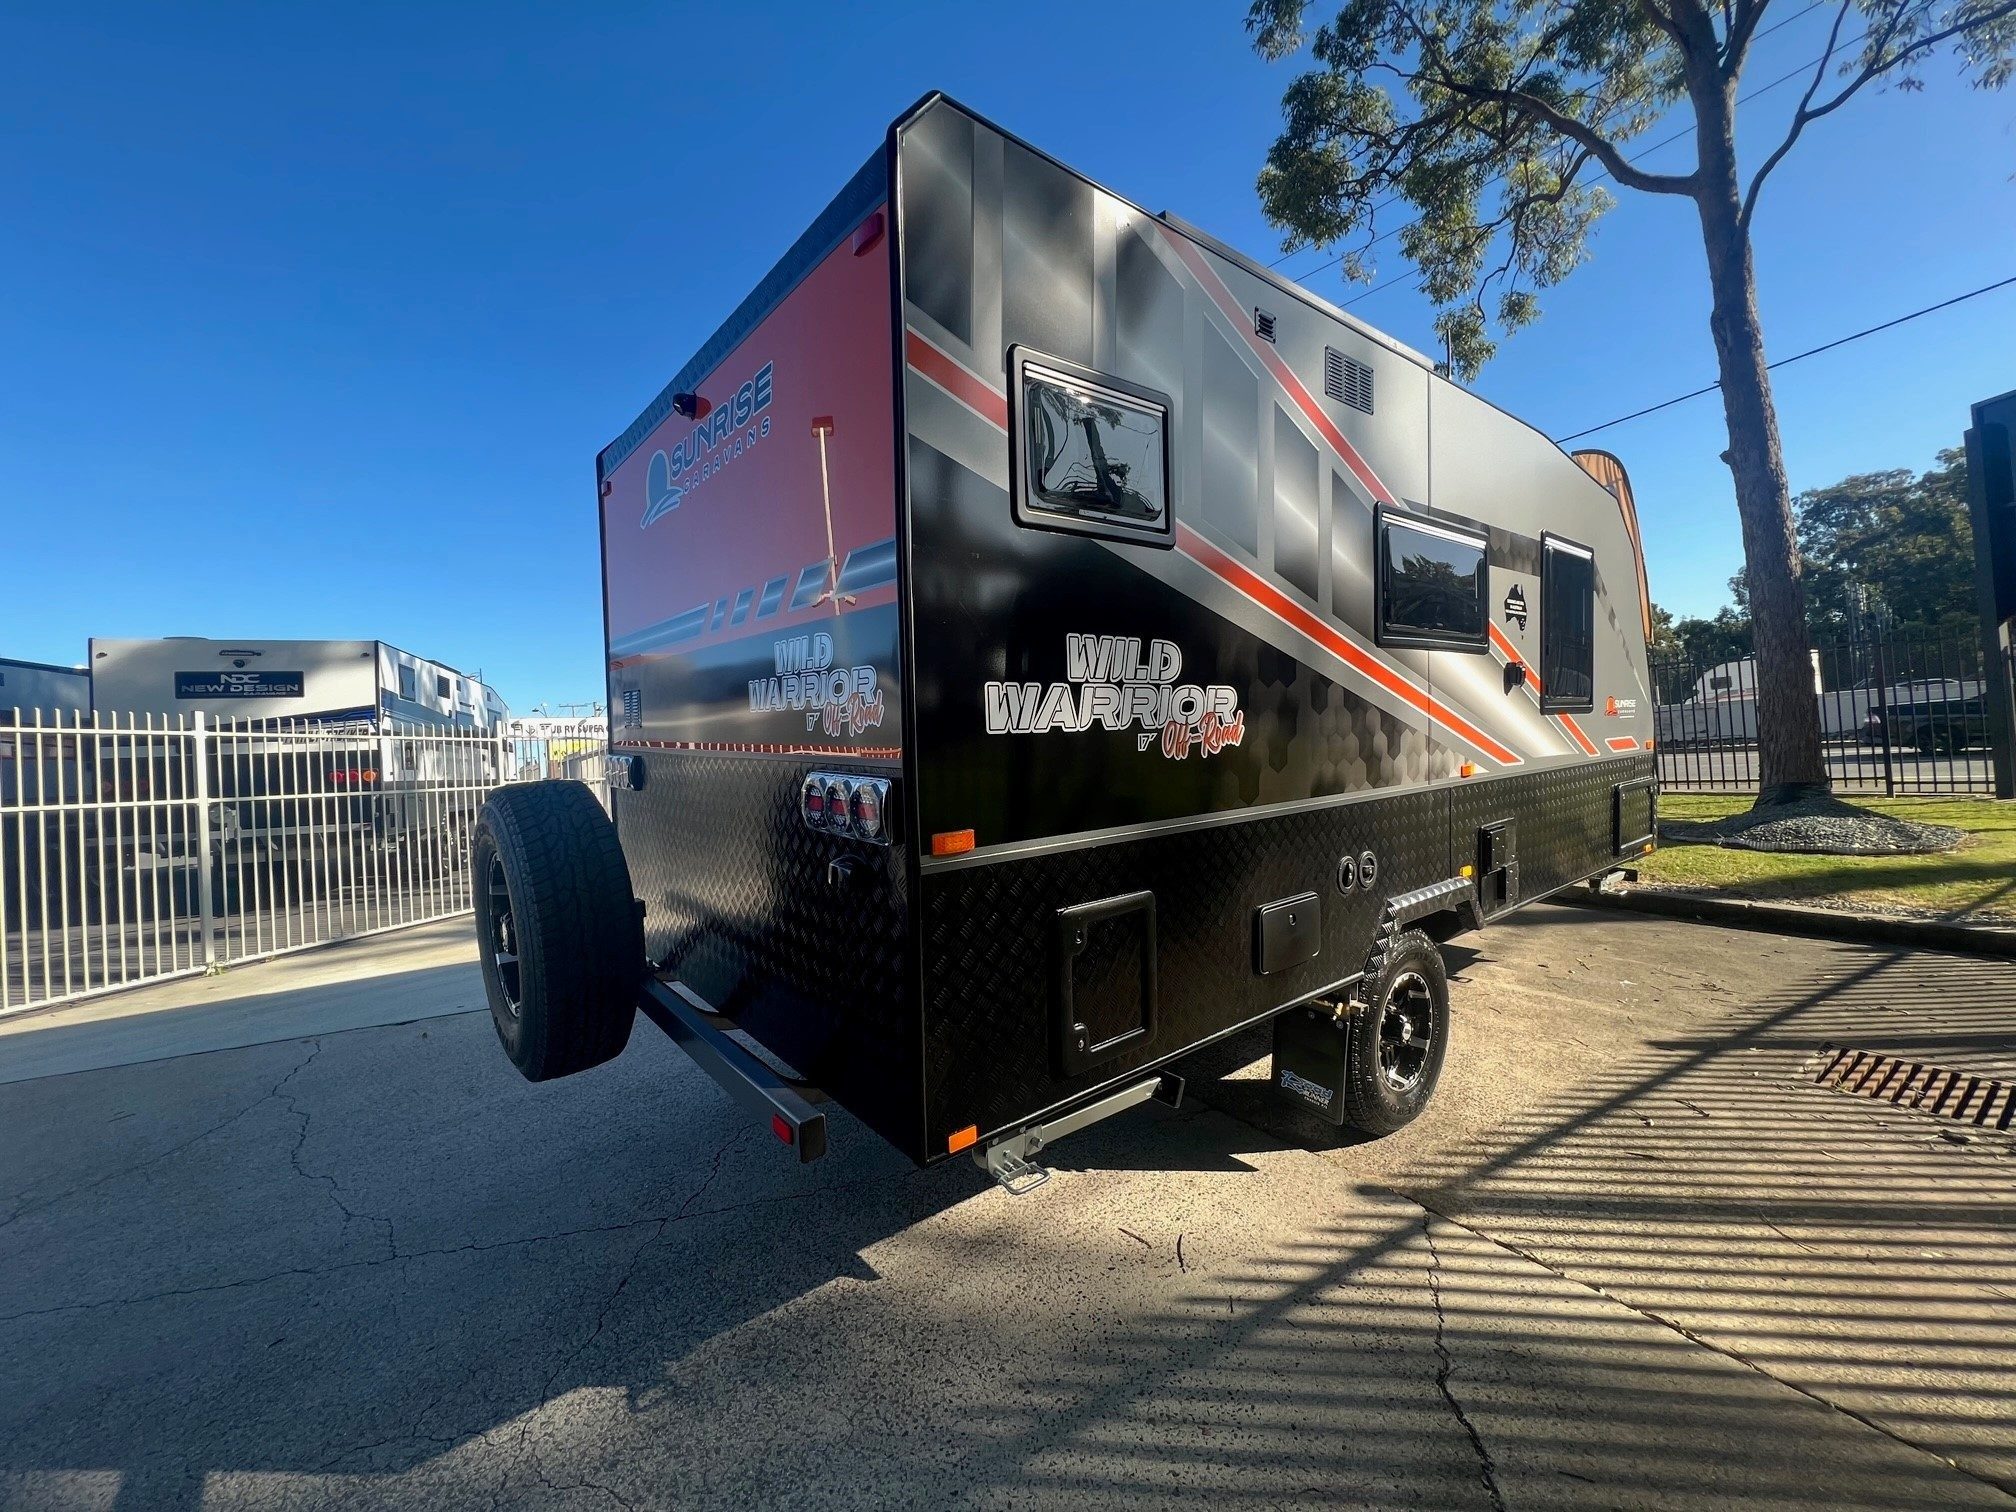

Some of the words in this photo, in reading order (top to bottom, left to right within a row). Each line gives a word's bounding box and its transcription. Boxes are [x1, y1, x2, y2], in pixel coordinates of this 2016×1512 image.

[671, 360, 773, 480] SUNRISE
[683, 416, 770, 494] CARAVANS
[774, 632, 834, 676] WILD
[1066, 633, 1182, 683] WILD
[181, 684, 224, 693] NEW
[230, 684, 299, 693] DESIGN
[220, 674, 260, 684] NDC
[748, 665, 877, 712] WARRIOR
[984, 681, 1238, 734] WARRIOR
